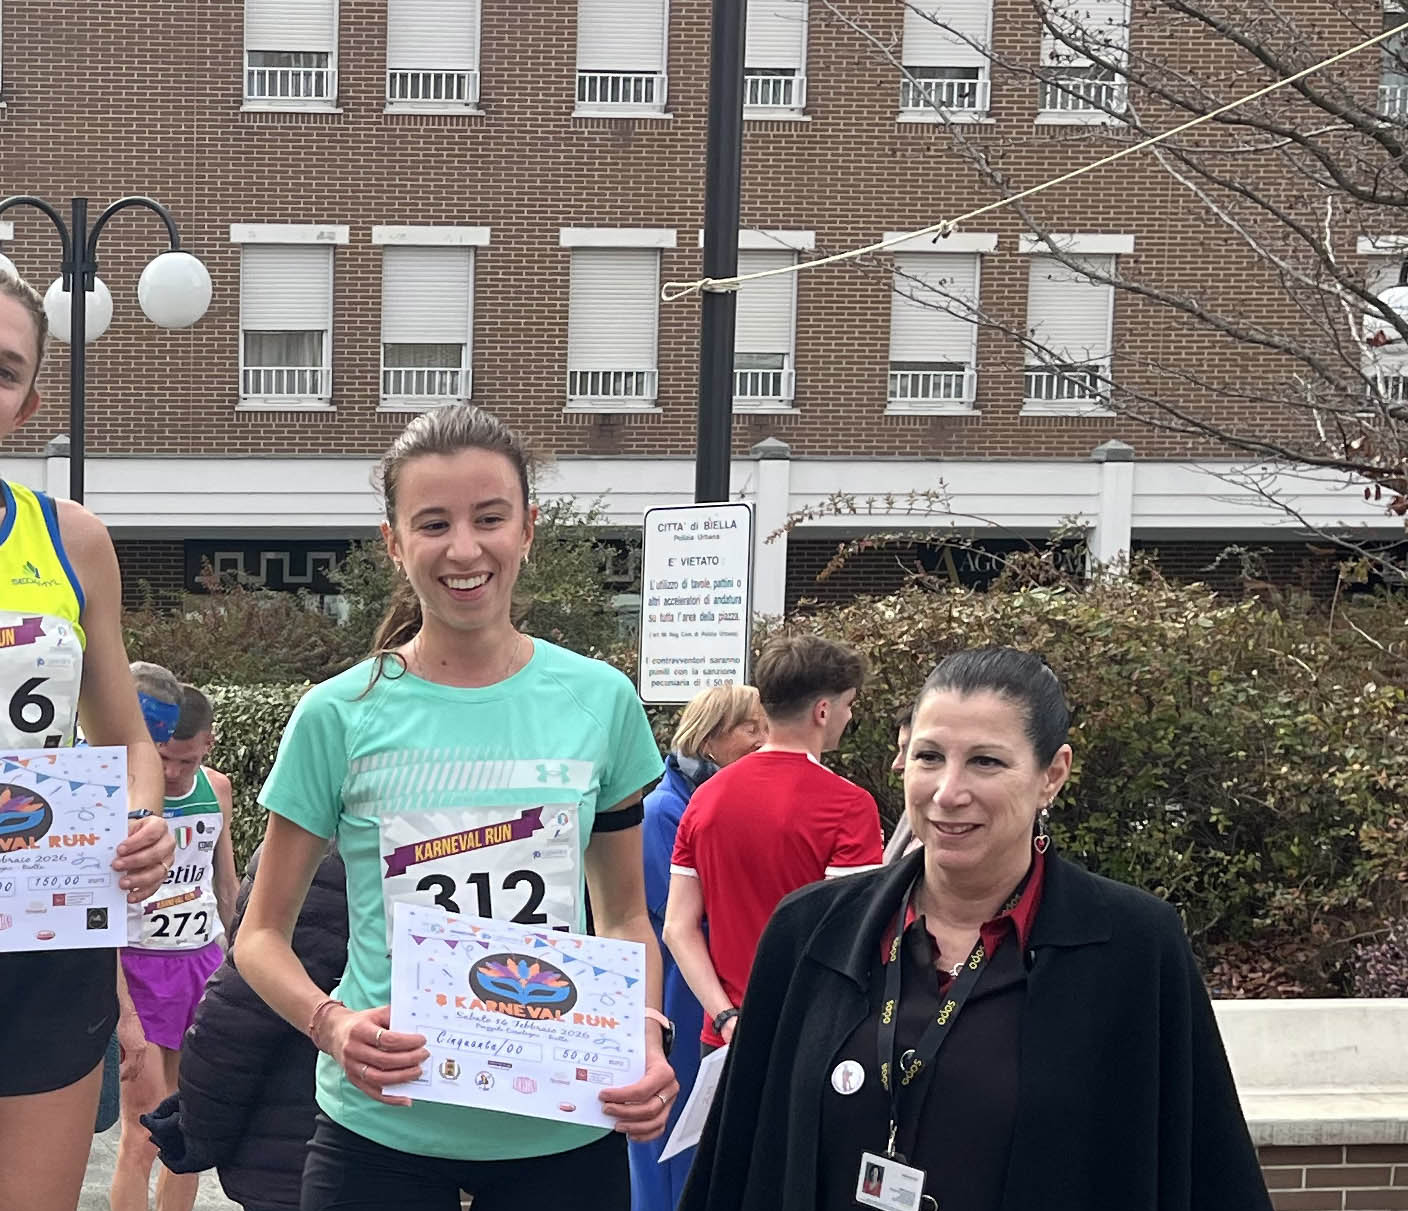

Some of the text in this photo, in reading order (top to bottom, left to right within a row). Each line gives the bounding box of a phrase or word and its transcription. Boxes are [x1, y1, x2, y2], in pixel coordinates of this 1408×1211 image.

[690, 520, 699, 531] di
[704, 519, 737, 530] BIELLA
[681, 578, 687, 589] di
[704, 594, 710, 605] di
[713, 594, 742, 605] andatura
[660, 612, 674, 622] tutta
[699, 611, 714, 621] della
[709, 656, 741, 664] saranno
[674, 668, 689, 676] con
[692, 667, 698, 676] la
[703, 668, 737, 676] sanzione
[651, 679, 689, 688] pecuniaria
[694, 678, 701, 687] di
[48, 832, 100, 848] RUN
[414, 823, 512, 863] KARNEVAL RUN
[35, 854, 67, 863] 2026
[34, 875, 80, 888] 150,00
[415, 869, 547, 925] 312
[150, 911, 208, 938] 272
[455, 995, 565, 1023] KARNEVAL
[574, 1012, 620, 1030] RUN
[937, 999, 956, 1025] odos
[560, 1028, 590, 1040] 2026
